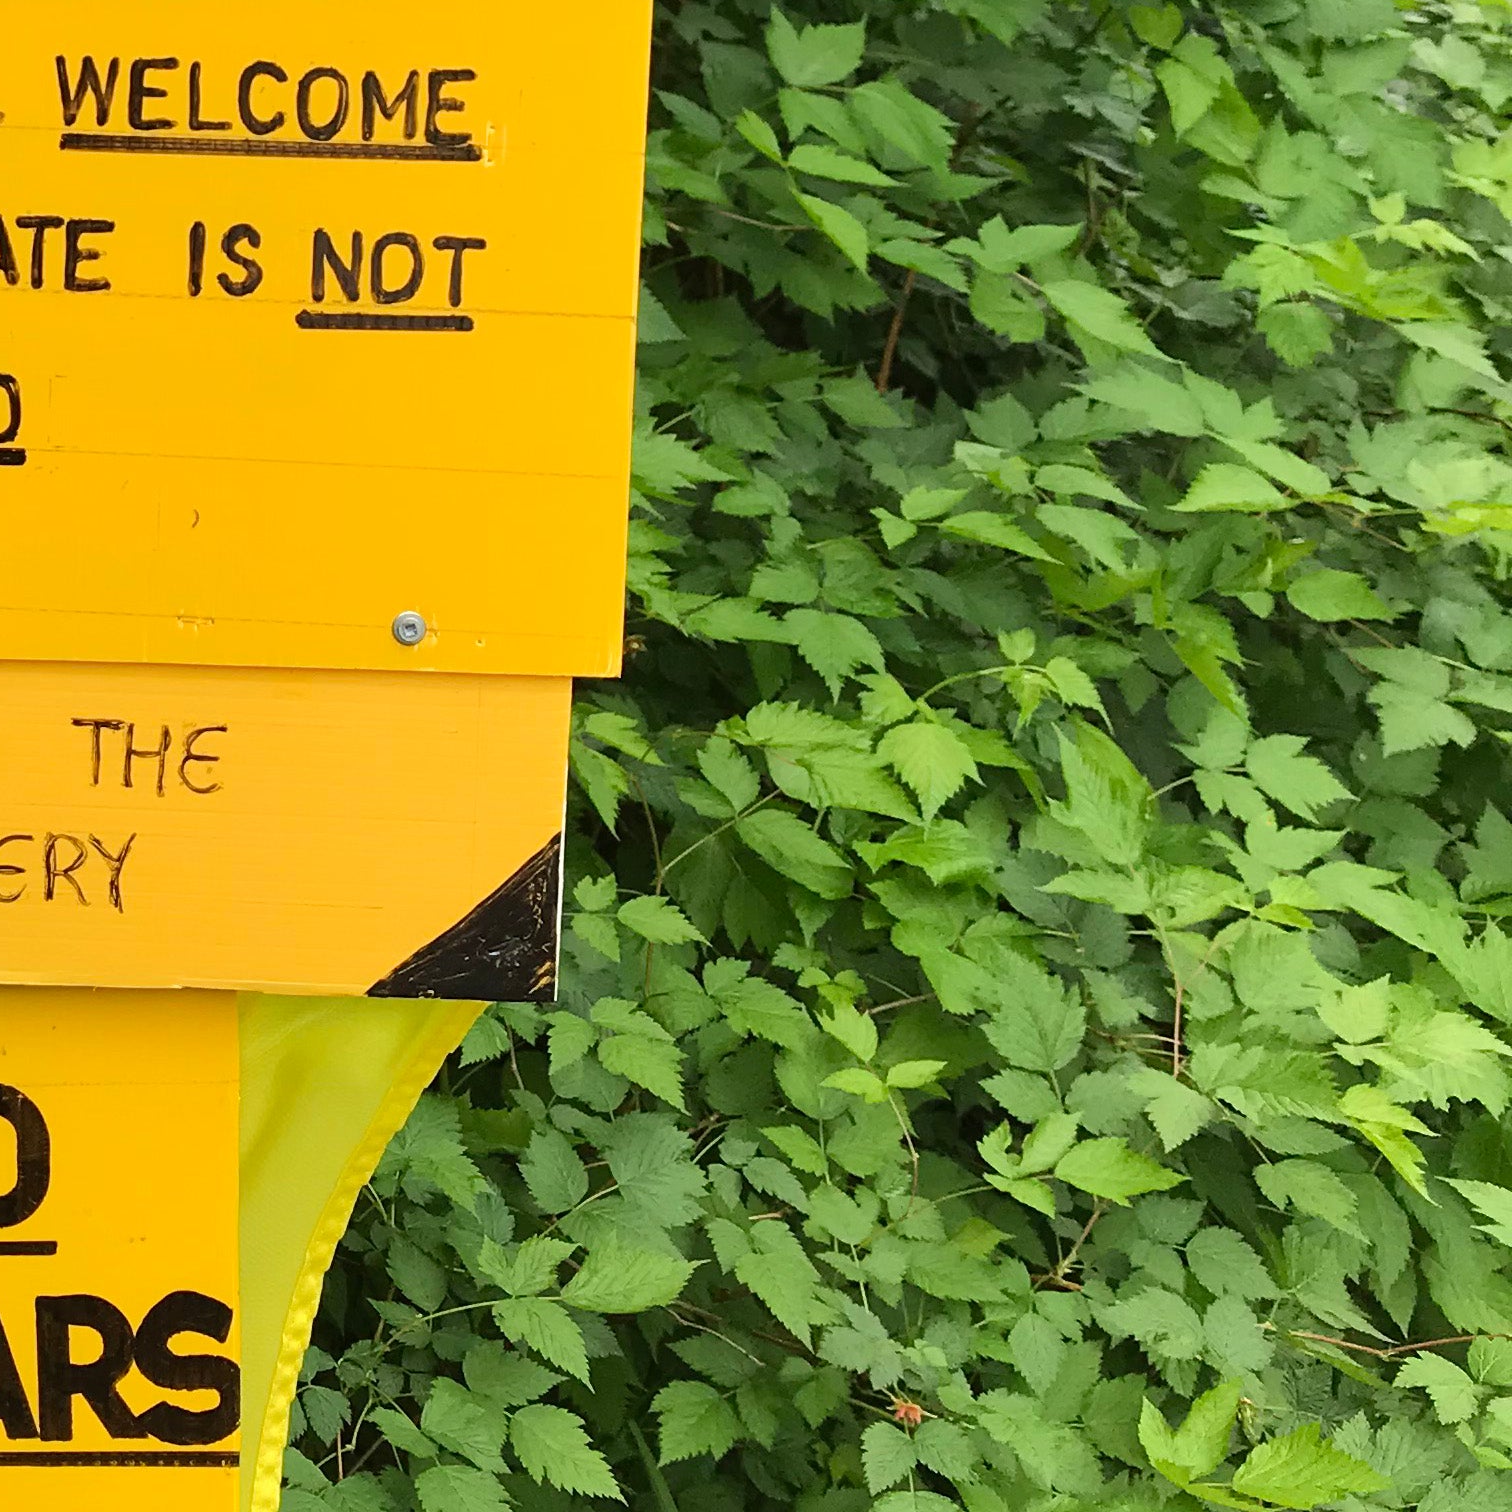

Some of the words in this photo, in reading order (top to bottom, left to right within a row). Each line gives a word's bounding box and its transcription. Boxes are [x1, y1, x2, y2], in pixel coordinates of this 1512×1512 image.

[56, 55, 476, 143] WELCOME
[189, 221, 262, 296] IS
[312, 228, 486, 307] NOT
[72, 719, 227, 793] THE
